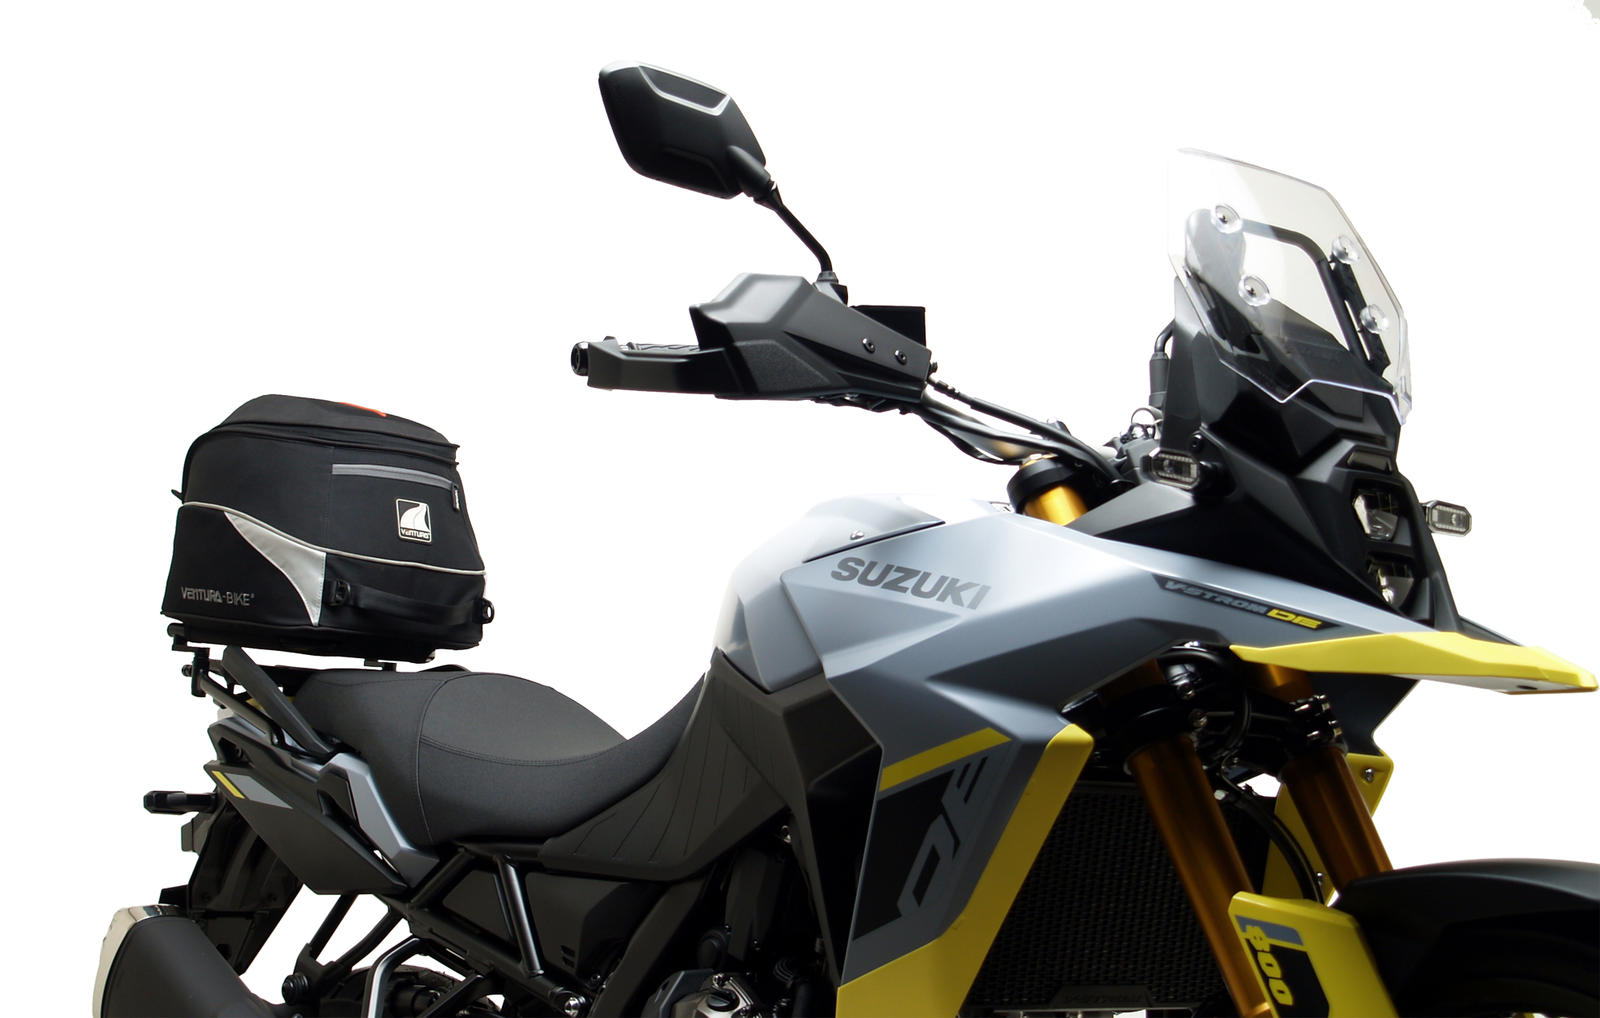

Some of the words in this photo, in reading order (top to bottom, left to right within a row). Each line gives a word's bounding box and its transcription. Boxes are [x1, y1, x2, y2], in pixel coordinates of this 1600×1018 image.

[831, 557, 991, 610] SUZUKI
[1164, 580, 1268, 614] V-STROM
[1267, 608, 1322, 630] DE
[1244, 924, 1293, 1006] 800
